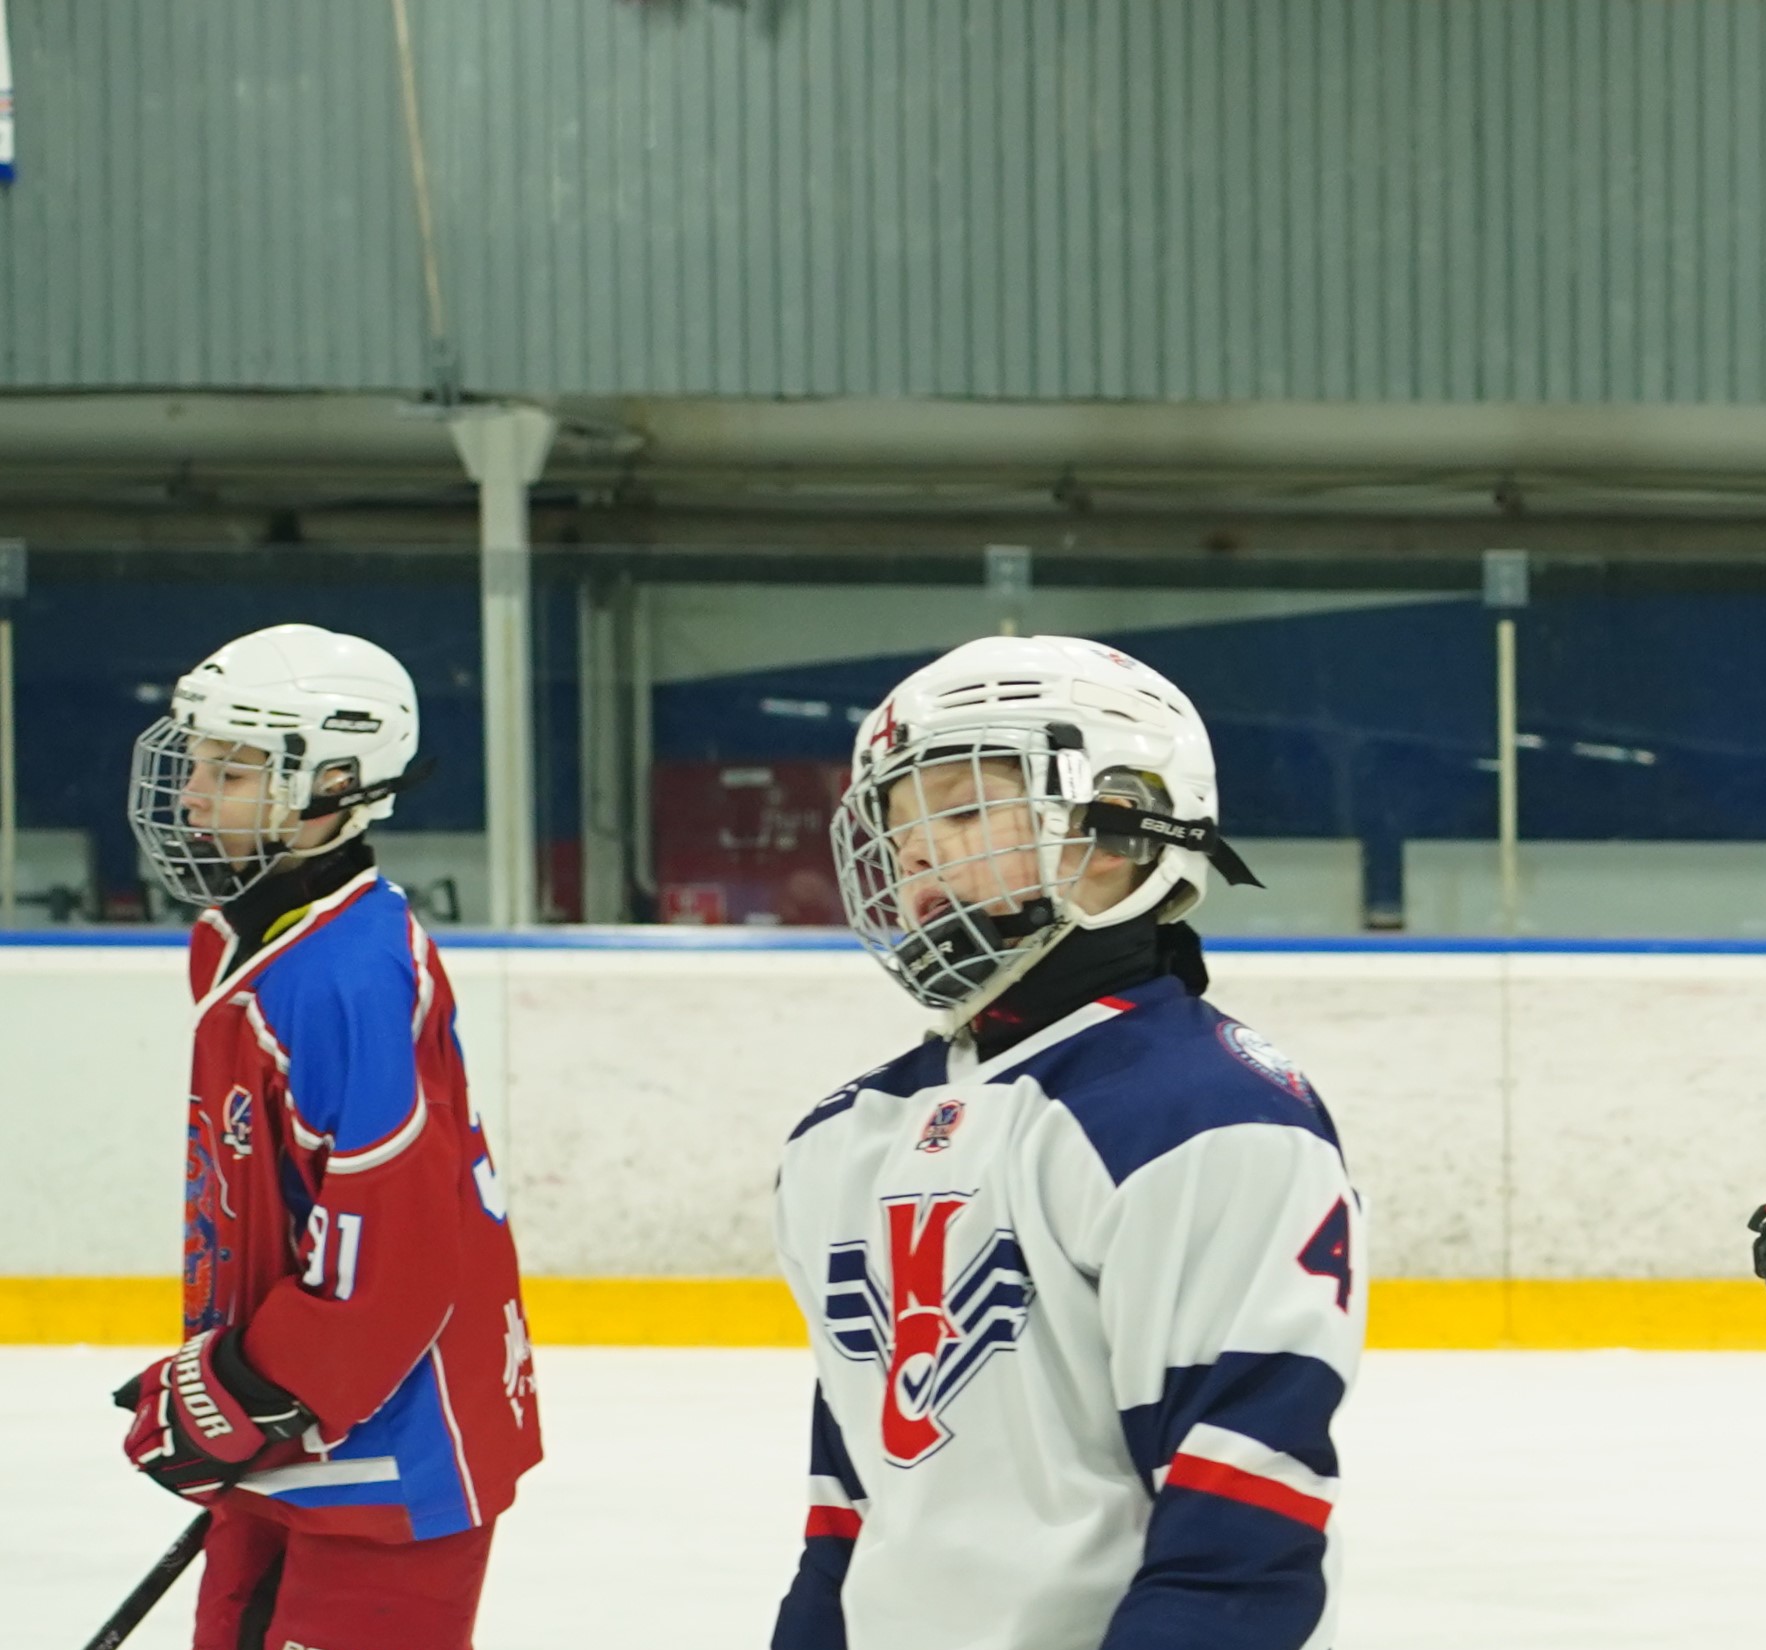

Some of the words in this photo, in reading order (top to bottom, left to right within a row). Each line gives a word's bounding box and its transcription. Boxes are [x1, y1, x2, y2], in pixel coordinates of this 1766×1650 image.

[869, 698, 898, 750] 4
[301, 1204, 363, 1301] 91
[1297, 1194, 1352, 1314] 4
